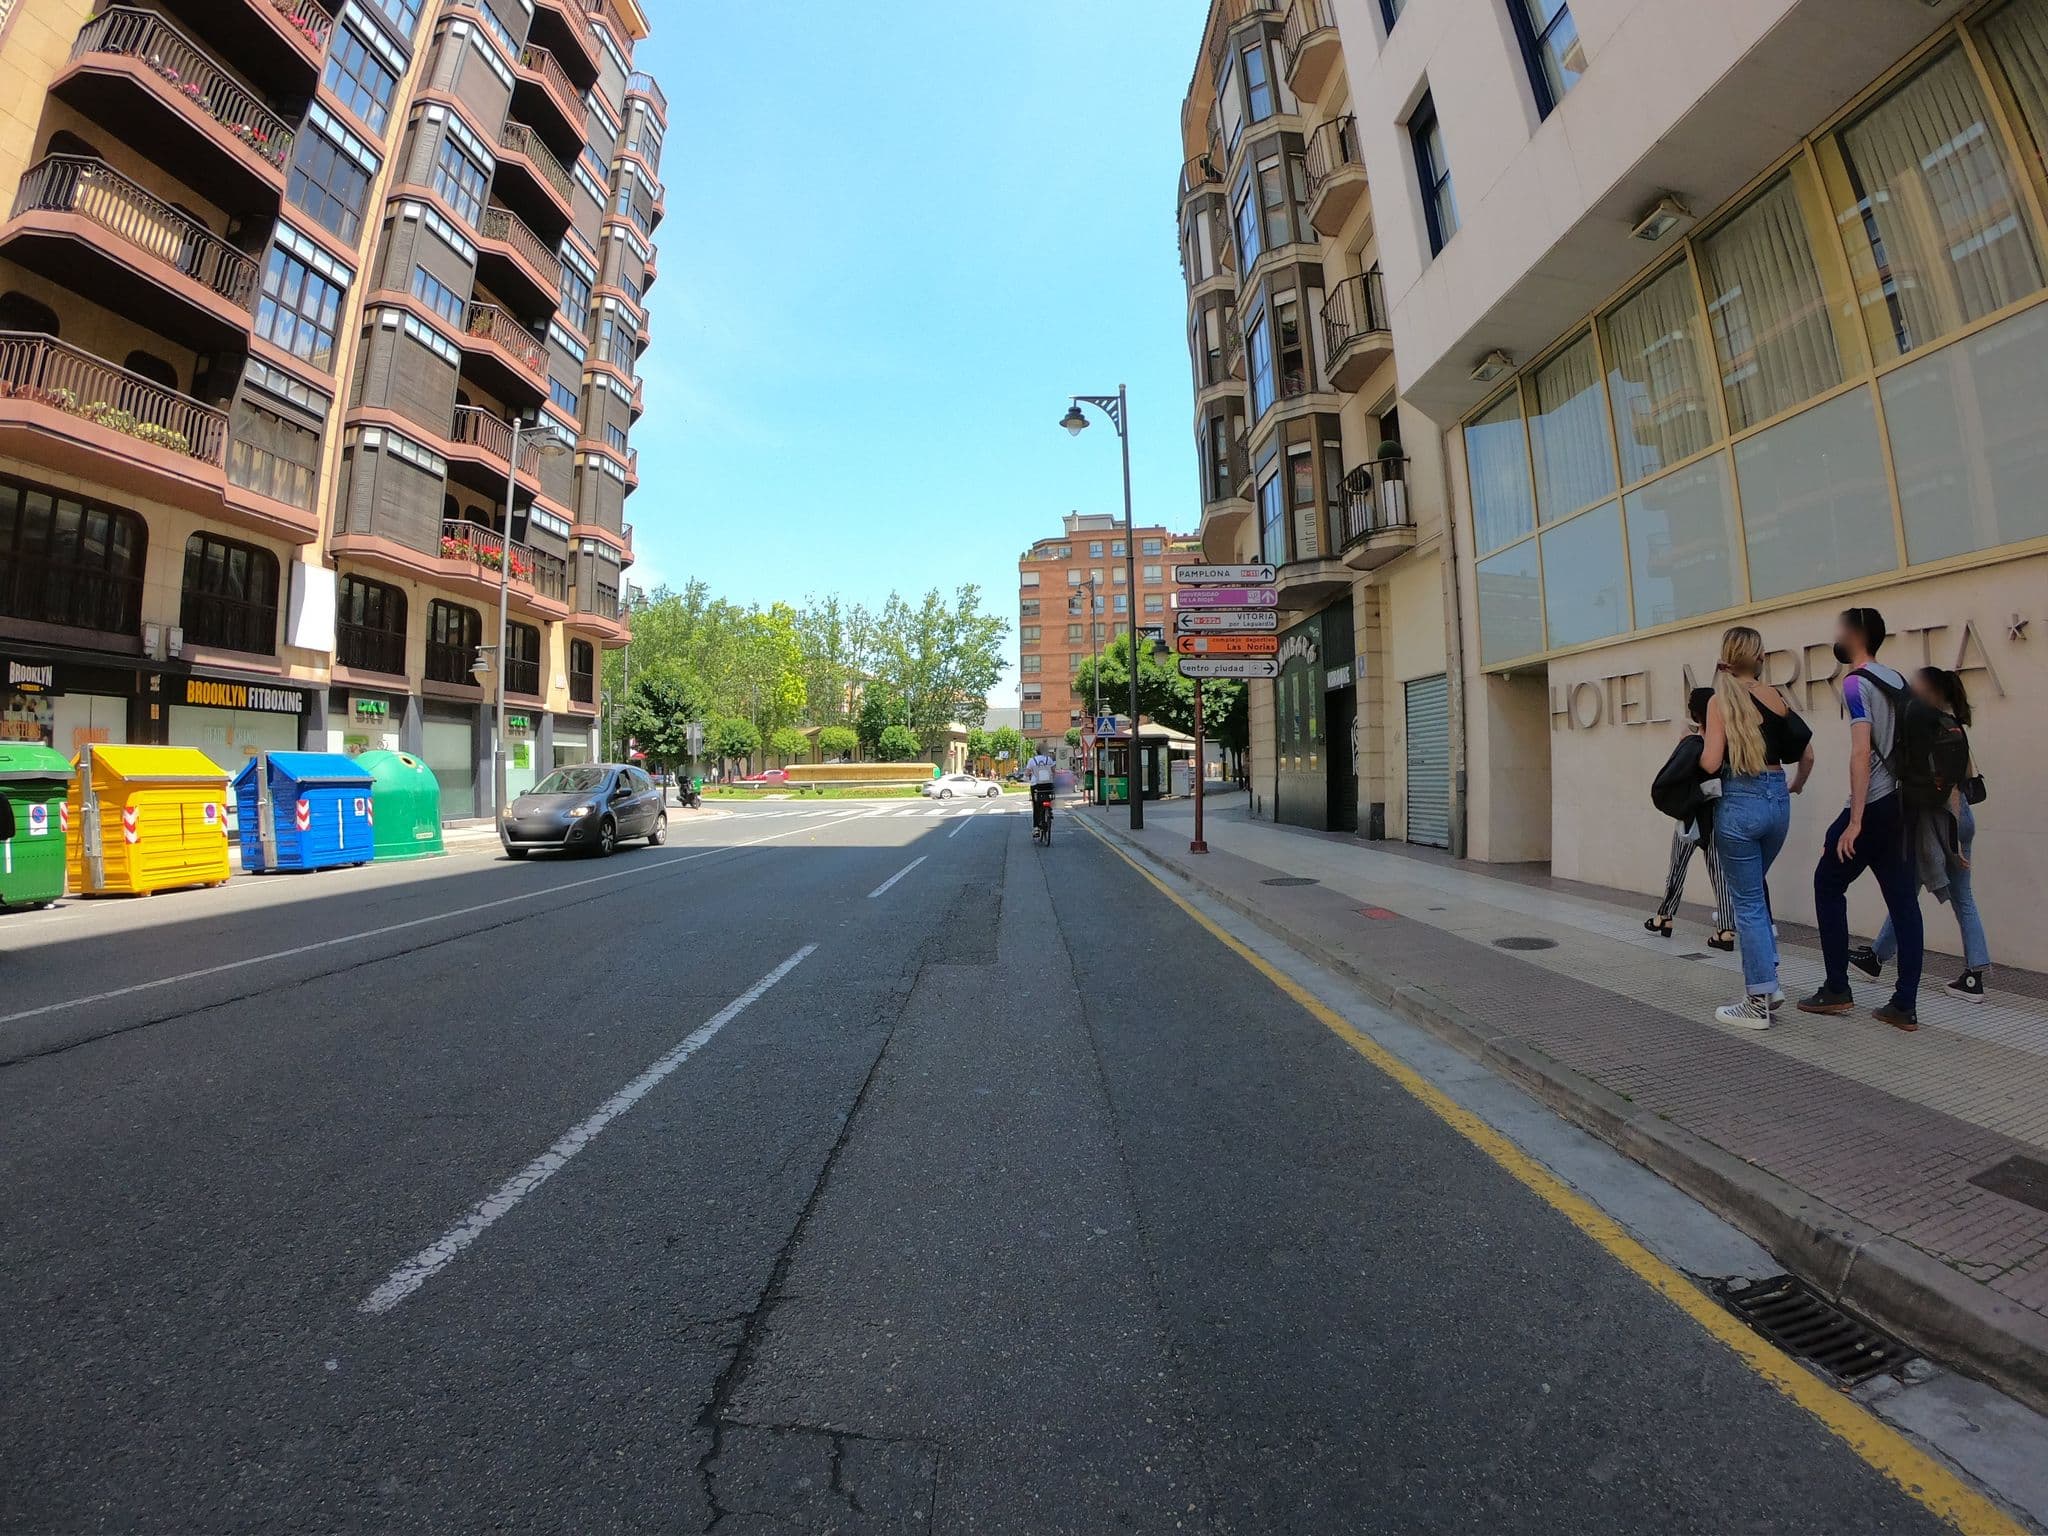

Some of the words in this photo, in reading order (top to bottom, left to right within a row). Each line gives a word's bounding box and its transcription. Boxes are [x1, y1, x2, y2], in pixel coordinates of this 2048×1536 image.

[1179, 570, 1231, 578] PAMPLONA
[9, 661, 53, 687] BROOKLYN
[1215, 662, 1244, 672] ciudad
[1551, 669, 1672, 732] HOTEL
[1682, 618, 2006, 722] MRRTA
[187, 679, 247, 707] BROOKLYN
[248, 687, 303, 713] FITBOXING
[356, 699, 387, 714] DKV
